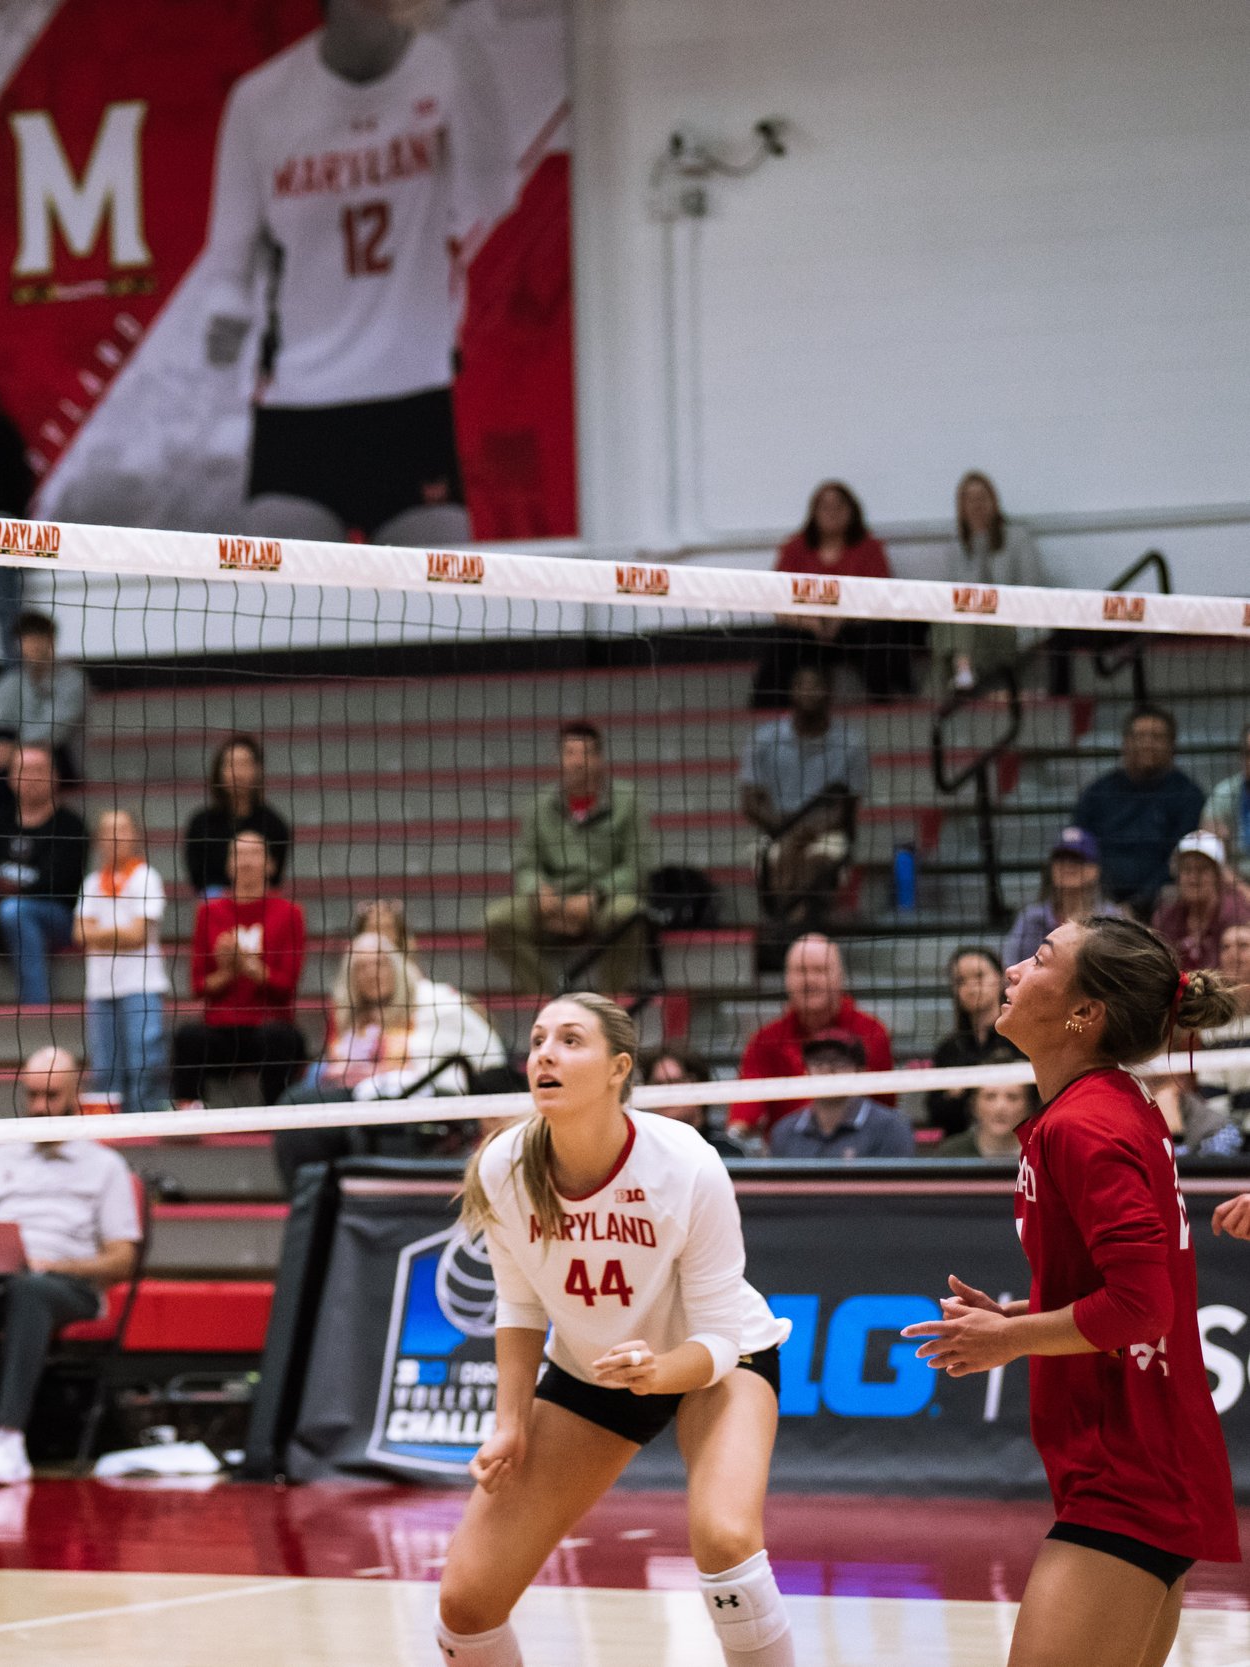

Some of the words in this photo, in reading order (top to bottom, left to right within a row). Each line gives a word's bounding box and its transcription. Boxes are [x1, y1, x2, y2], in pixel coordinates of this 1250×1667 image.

[9, 98, 150, 278] M
[218, 537, 282, 565] MARYLAND
[564, 1259, 634, 1307] 44
